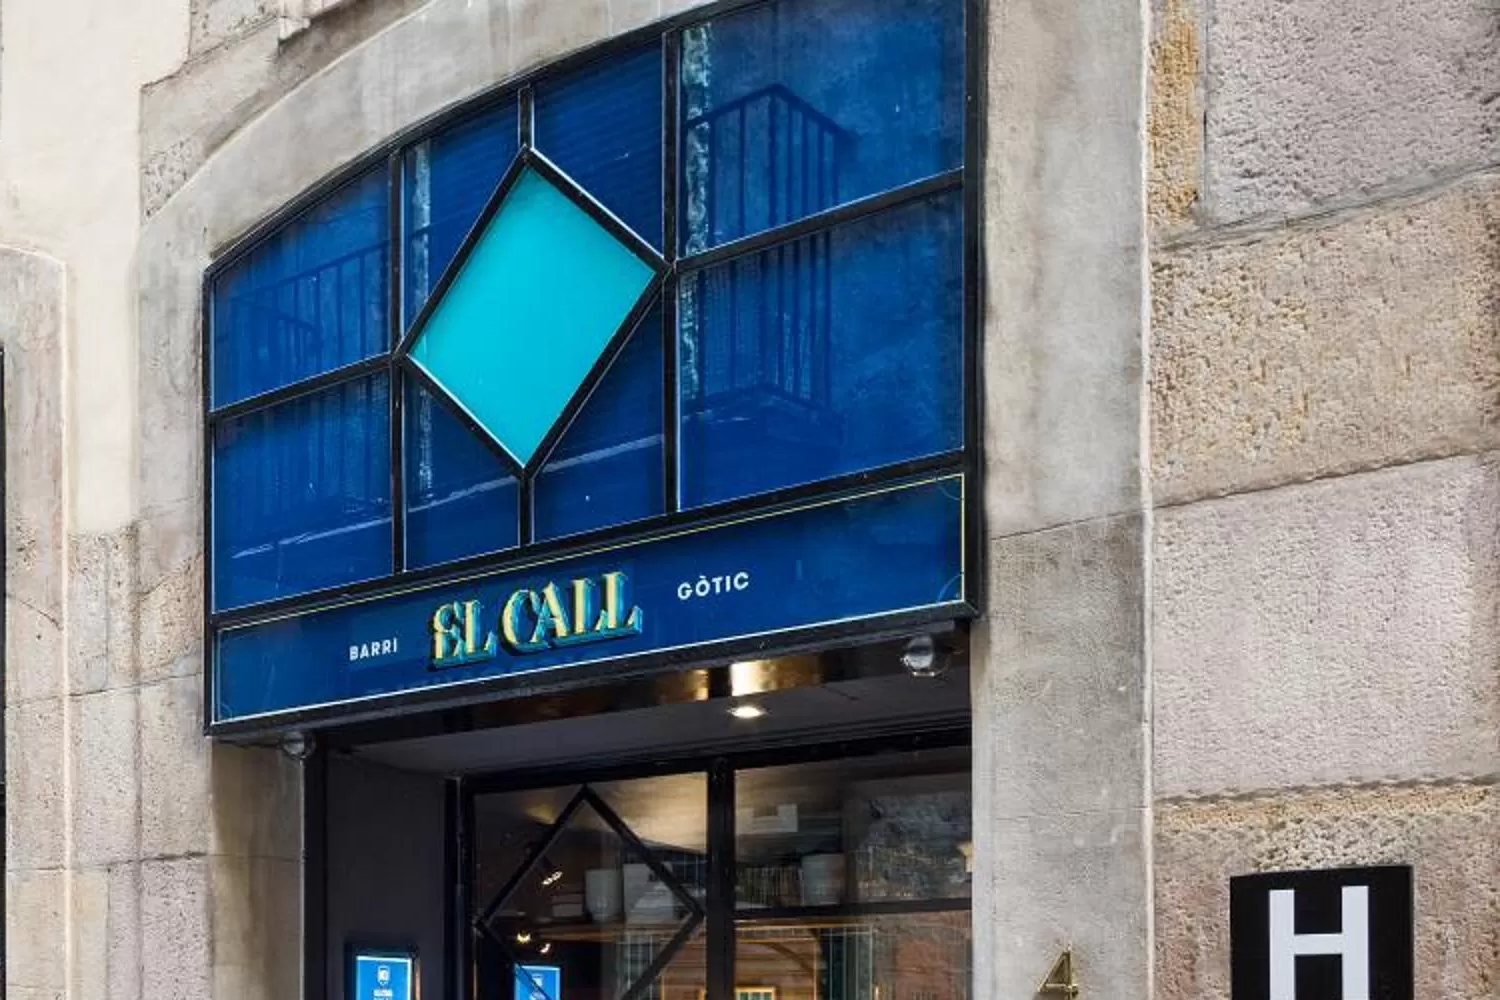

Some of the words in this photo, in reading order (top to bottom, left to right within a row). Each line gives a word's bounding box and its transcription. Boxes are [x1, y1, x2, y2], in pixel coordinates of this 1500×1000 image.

[349, 637, 398, 661] BARRI
[431, 599, 497, 668] EL
[501, 571, 643, 653] CALL
[677, 571, 750, 600] GÒTIC
